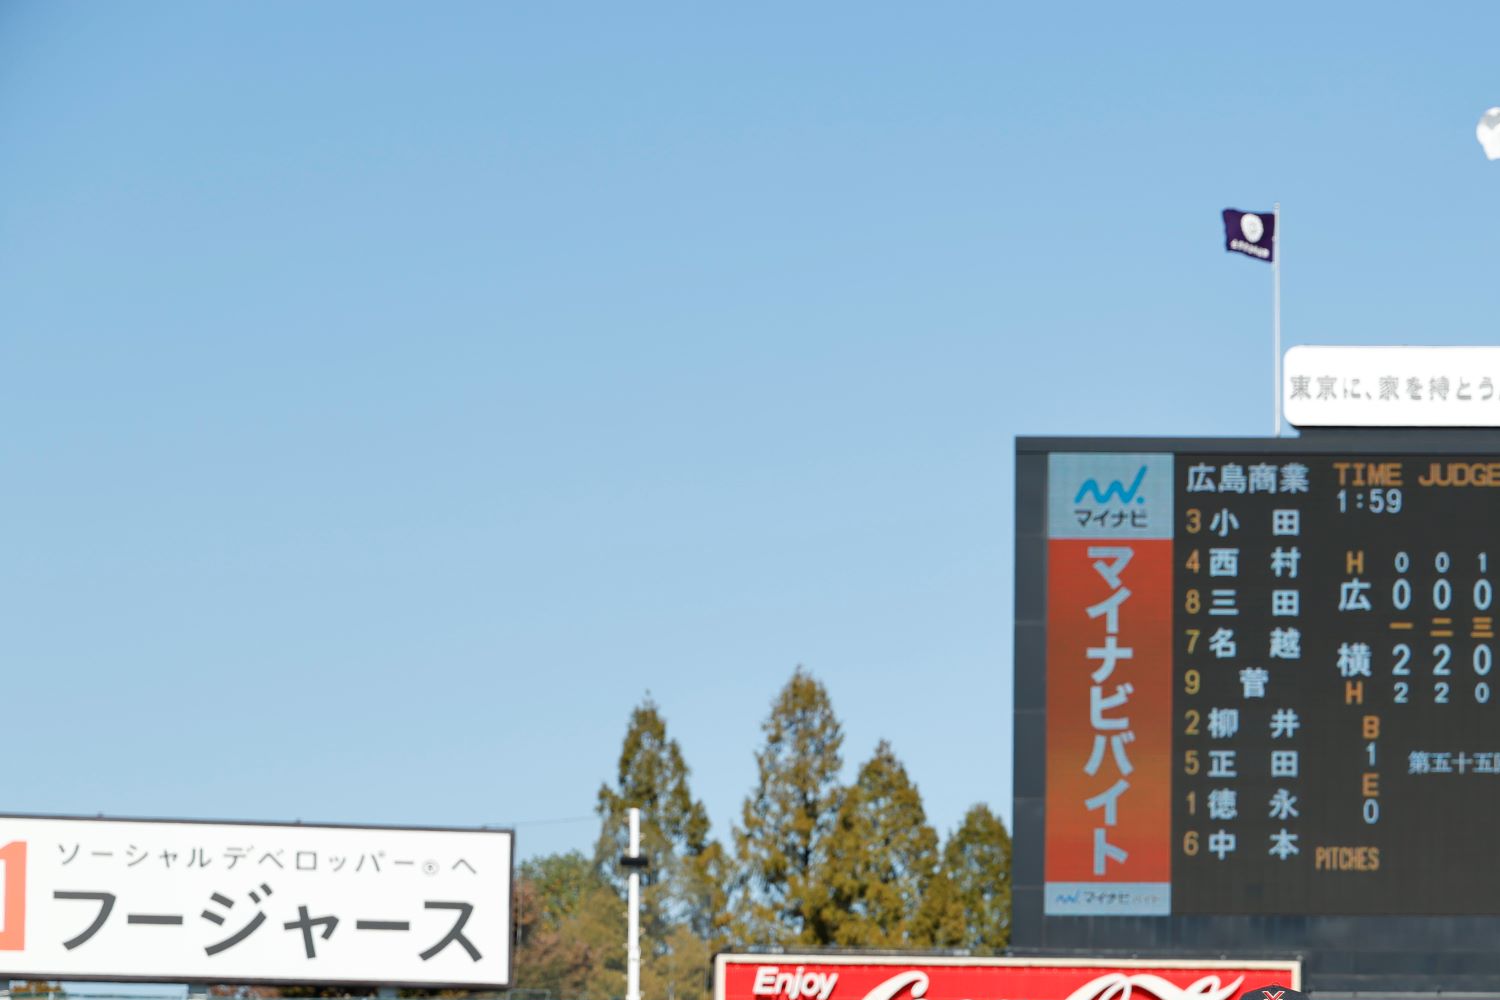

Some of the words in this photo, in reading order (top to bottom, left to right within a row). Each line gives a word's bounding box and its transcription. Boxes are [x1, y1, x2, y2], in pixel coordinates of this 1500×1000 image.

[1186, 462, 1309, 494] 広島商業
[1333, 462, 1403, 487] TIME
[1337, 488, 1403, 514] 1:59
[1073, 509, 1147, 528] マイナビ
[1186, 508, 1202, 534] 3
[1185, 549, 1200, 573] 4
[1346, 550, 1364, 574] H
[1394, 551, 1410, 574] 0
[1434, 551, 1450, 574] 0
[1478, 552, 1488, 573] 1
[1184, 588, 1201, 615] 8
[1338, 578, 1372, 611] 広
[1392, 578, 1412, 611] 0
[1432, 578, 1452, 611] 0
[1473, 578, 1493, 611] 0
[1430, 617, 1454, 637] 二
[1470, 616, 1494, 639] 三
[1185, 628, 1201, 654] 7
[1336, 642, 1372, 677] 横
[1391, 643, 1411, 676] 2
[1432, 643, 1452, 676] 2
[1472, 643, 1492, 676] 0
[1184, 669, 1201, 695] 9
[1345, 680, 1363, 704] H
[1393, 681, 1409, 704] 2
[1434, 681, 1450, 704] 2
[1474, 681, 1490, 704] 0
[1085, 548, 1134, 874] マイナビバイト
[1184, 709, 1200, 735] 2
[1362, 715, 1380, 739] B
[1184, 749, 1200, 775] 5
[1366, 742, 1376, 766] 1
[1362, 772, 1379, 797] E
[1186, 791, 1196, 815] 1
[1363, 798, 1380, 825] 0
[1183, 830, 1199, 856] 6
[1315, 846, 1380, 871] PITCHES
[52, 882, 484, 962] フージャース
